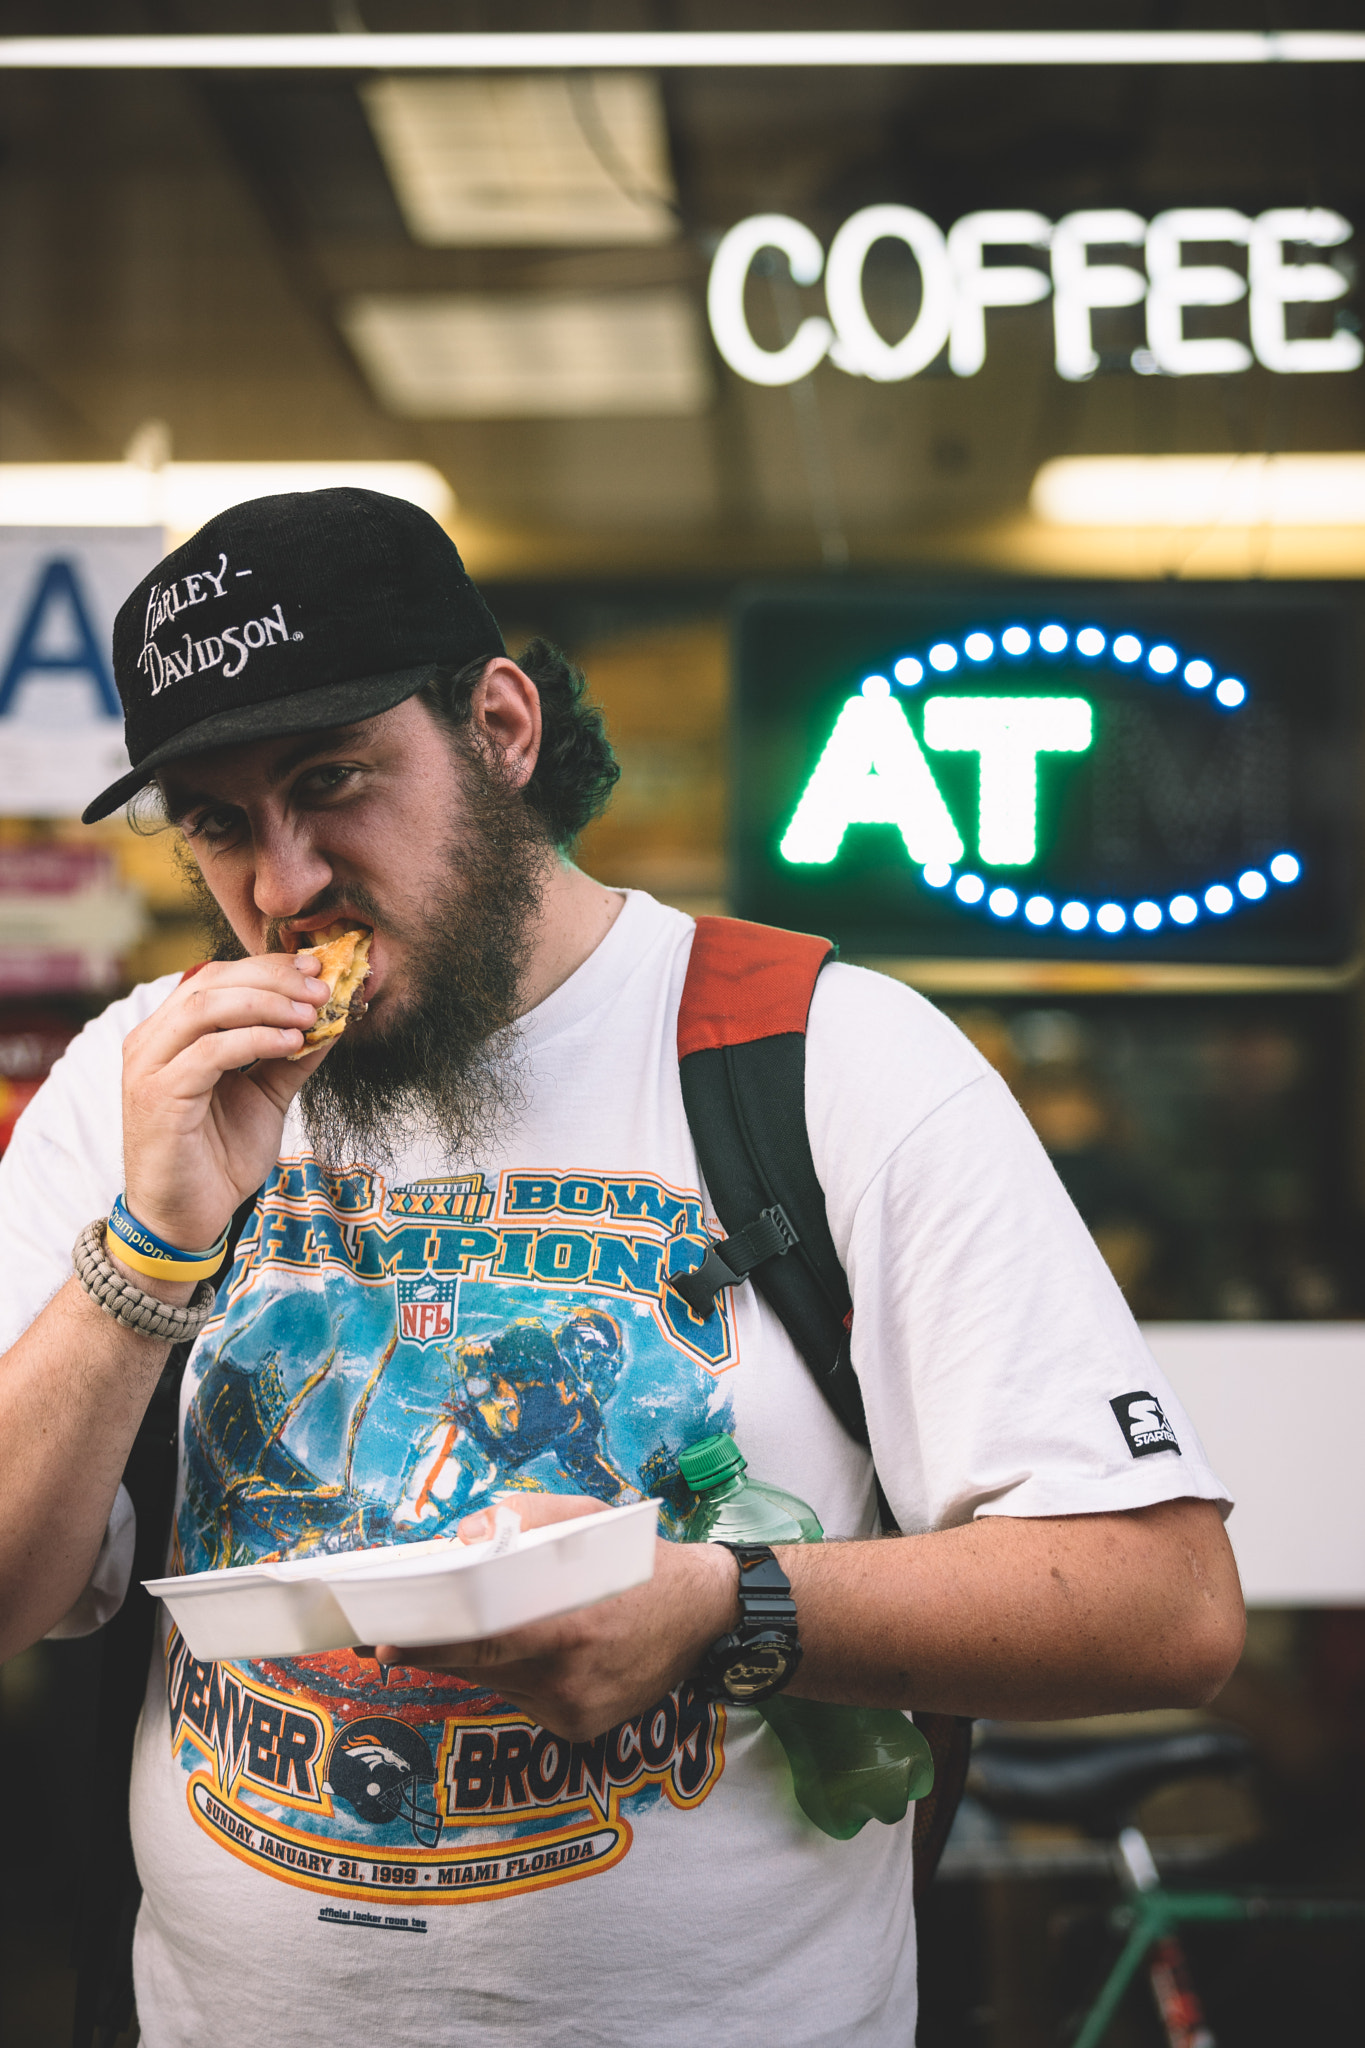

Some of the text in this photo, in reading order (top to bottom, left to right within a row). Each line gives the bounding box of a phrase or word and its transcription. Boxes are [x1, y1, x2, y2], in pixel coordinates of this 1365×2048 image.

[708, 204, 1364, 386] COFFEE
[0, 555, 121, 717] A
[389, 1192, 493, 1218] XXXIII
[504, 1174, 713, 1242] BOWL
[401, 1304, 450, 1339] NFL
[168, 1630, 711, 1812] DENVER BRONCOS
[205, 1797, 595, 1885] SUNDAY, JANUARY 31, 1999 MIAMI FLORIDA
[319, 1906, 428, 1928] official locker room tee
